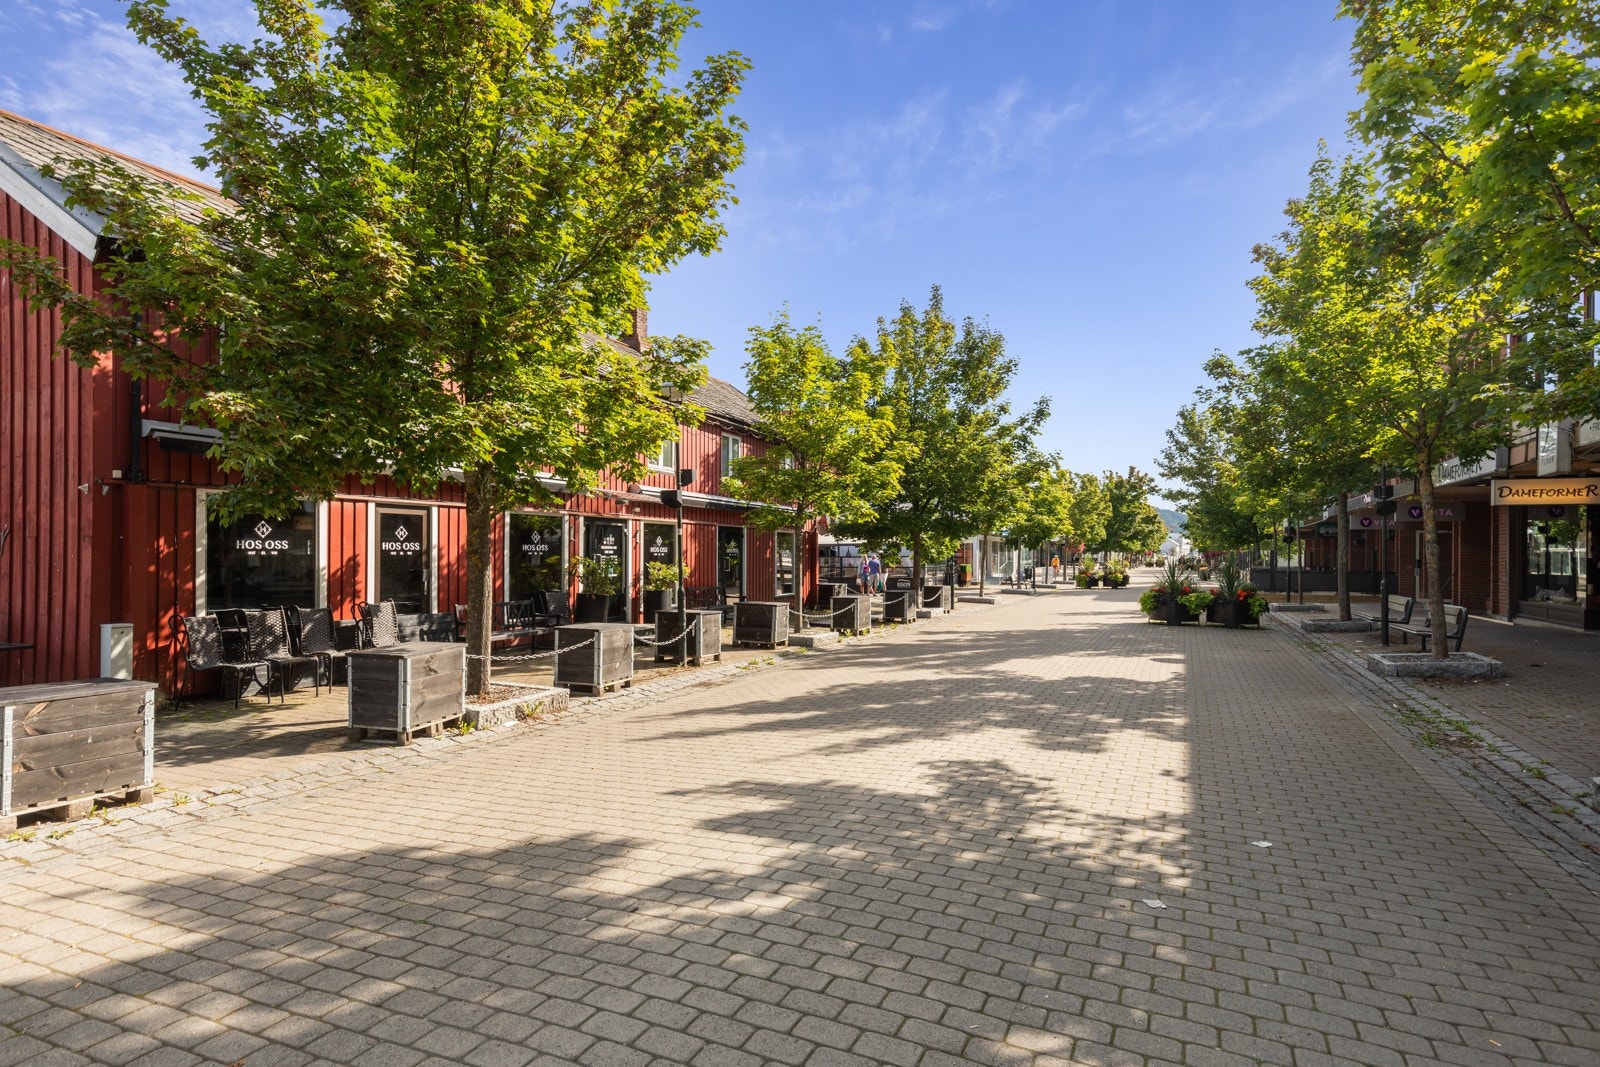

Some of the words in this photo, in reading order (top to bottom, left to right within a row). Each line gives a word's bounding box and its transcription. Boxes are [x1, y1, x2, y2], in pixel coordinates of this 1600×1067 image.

[1498, 484, 1599, 498] DAMEFORMER
[236, 540, 263, 550] HOS
[264, 540, 289, 550] OSS
[382, 542, 401, 550] HOS
[402, 542, 420, 550] OSS
